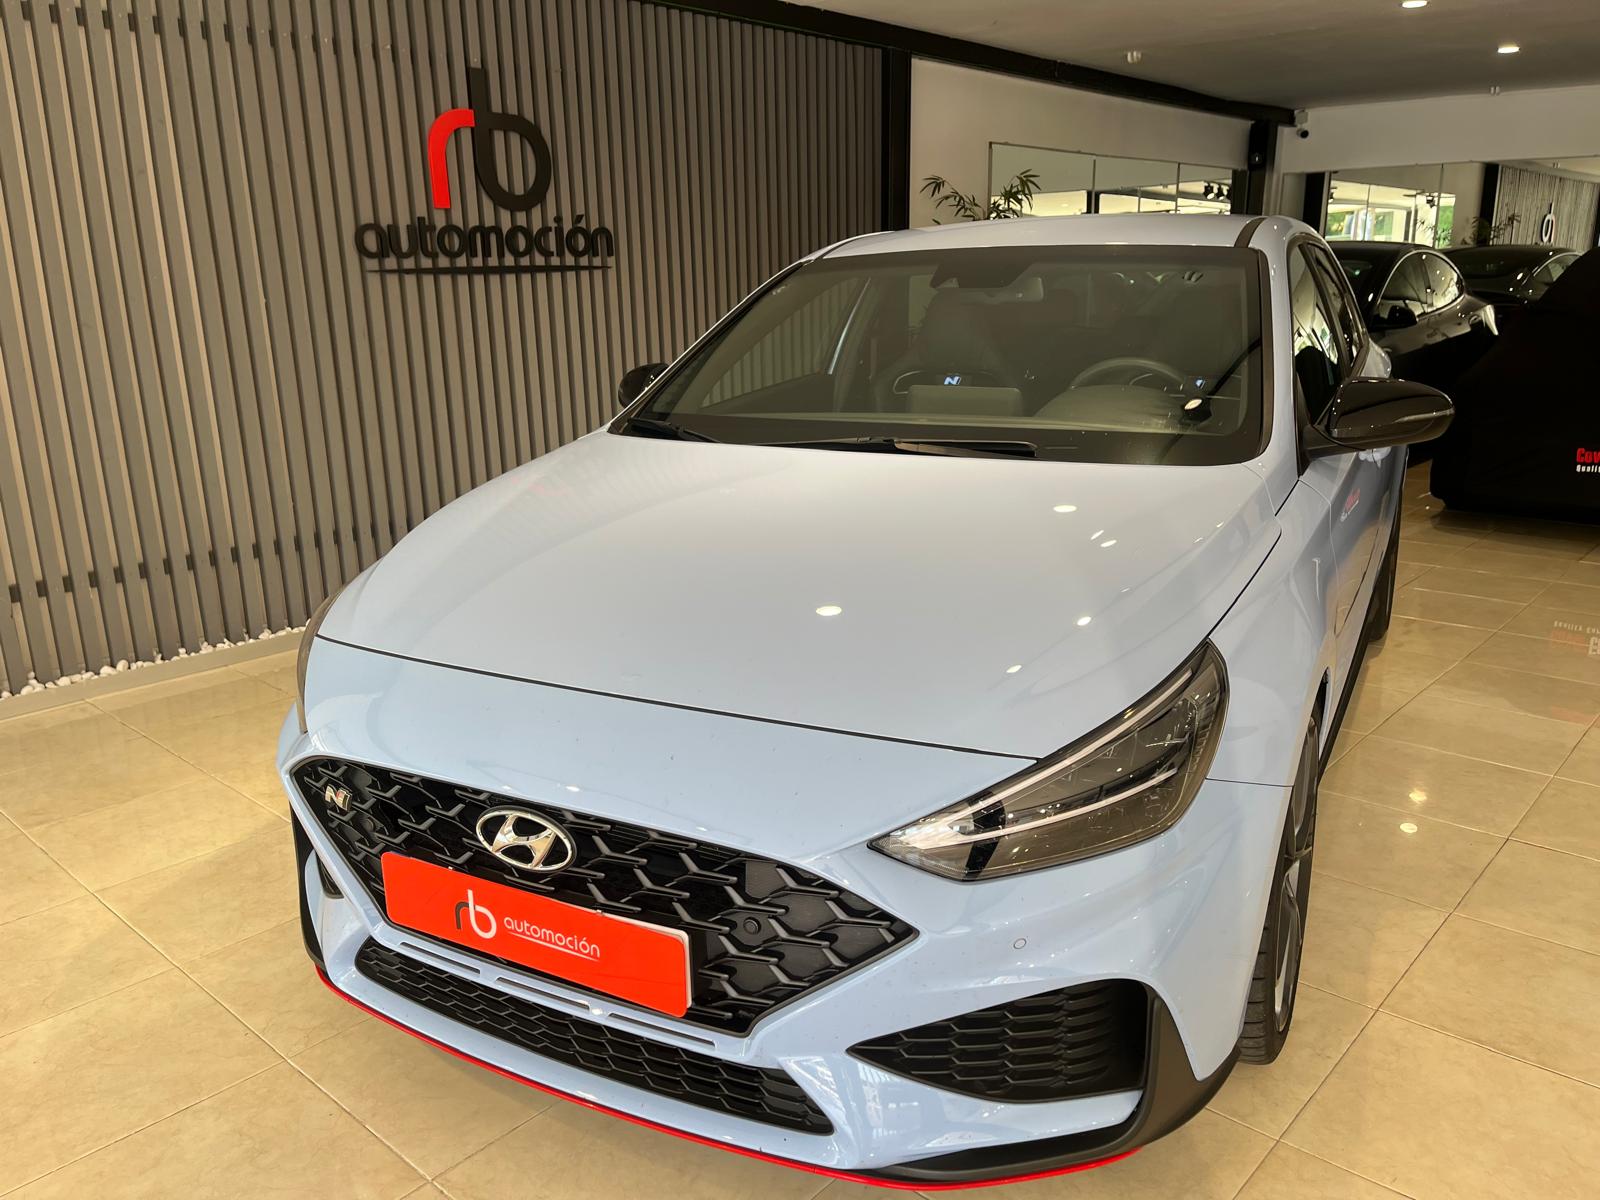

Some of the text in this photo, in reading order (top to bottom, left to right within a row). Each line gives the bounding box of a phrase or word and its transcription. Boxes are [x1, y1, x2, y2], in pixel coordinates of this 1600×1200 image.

[428, 67, 551, 212] rb
[354, 214, 614, 259] automoción
[325, 785, 350, 811] N
[455, 889, 601, 958] rb automoción
